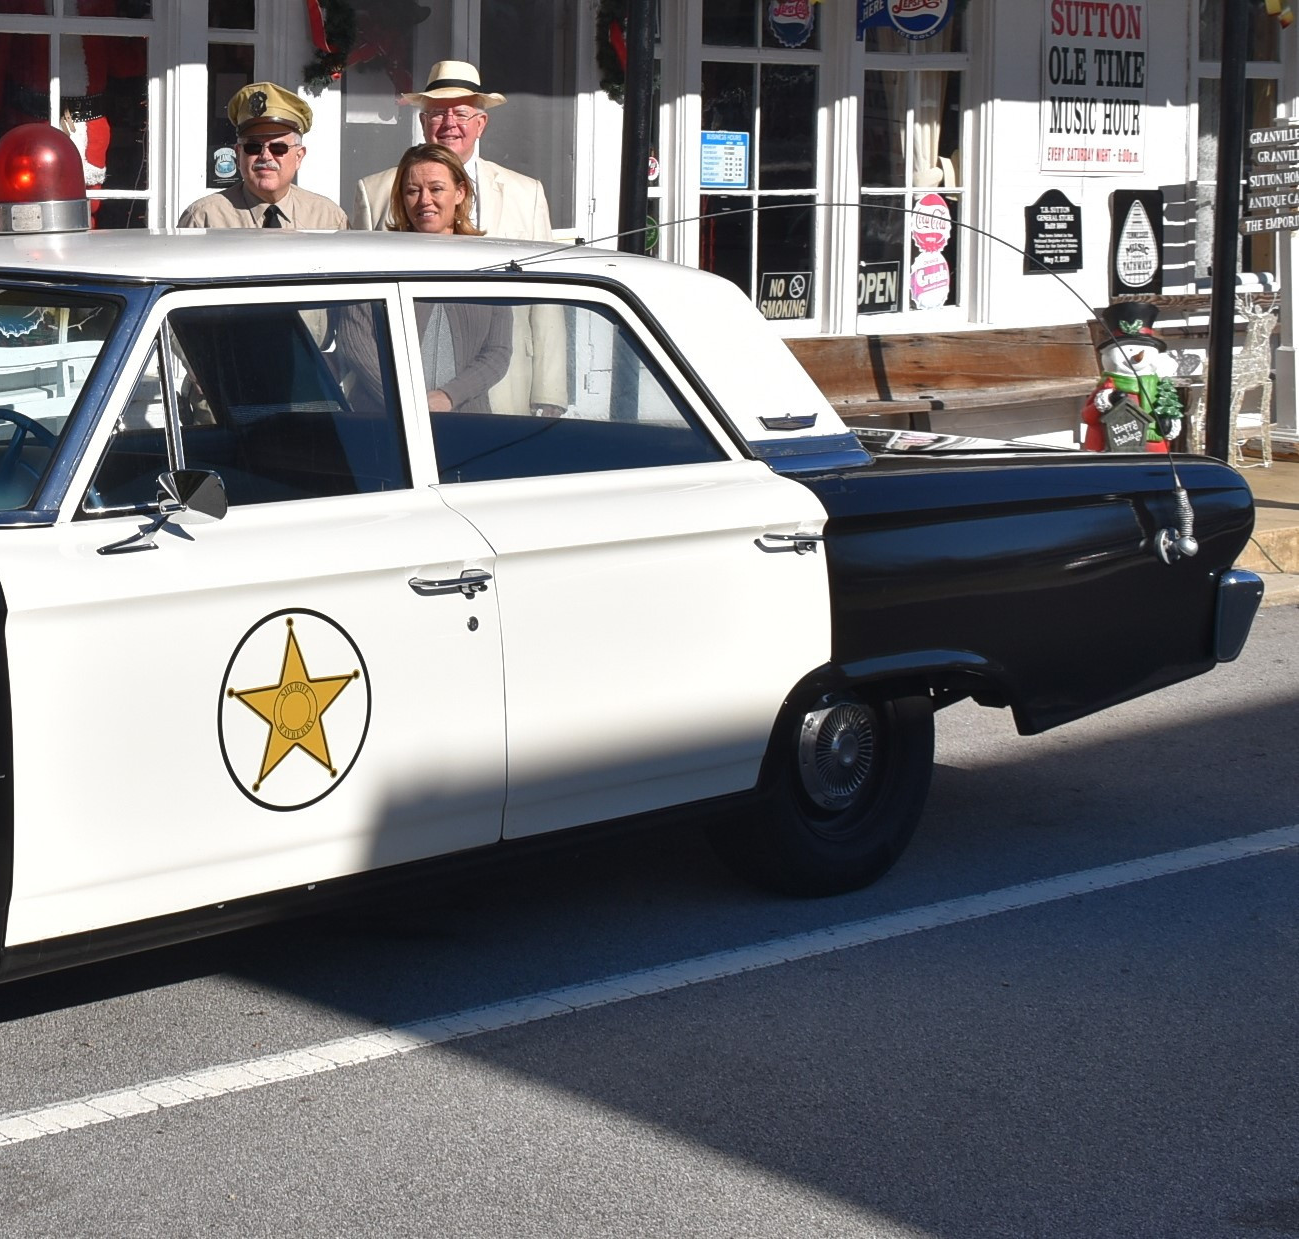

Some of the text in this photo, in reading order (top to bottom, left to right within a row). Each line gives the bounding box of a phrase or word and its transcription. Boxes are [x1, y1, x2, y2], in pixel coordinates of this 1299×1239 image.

[1050, 0, 1142, 40] SUTTON
[912, 29, 937, 40] COLD
[1048, 45, 1145, 89] OLE TIME
[1049, 95, 1141, 137] MUSIC HOUR
[1047, 146, 1065, 162] EVERY
[1067, 147, 1094, 162] SATURDAY
[1096, 148, 1112, 163] NIGHT
[1249, 173, 1283, 188] SUTTON
[1248, 194, 1287, 209] ANTIQUE
[1245, 219, 1264, 233] THE
[1125, 242, 1150, 257] MUSIC
[768, 277, 786, 298] NO
[858, 270, 898, 306] OPEN
[760, 299, 806, 319] SMOKING
[280, 682, 311, 697] SHERIFF
[278, 718, 314, 739] MAYBERRY
